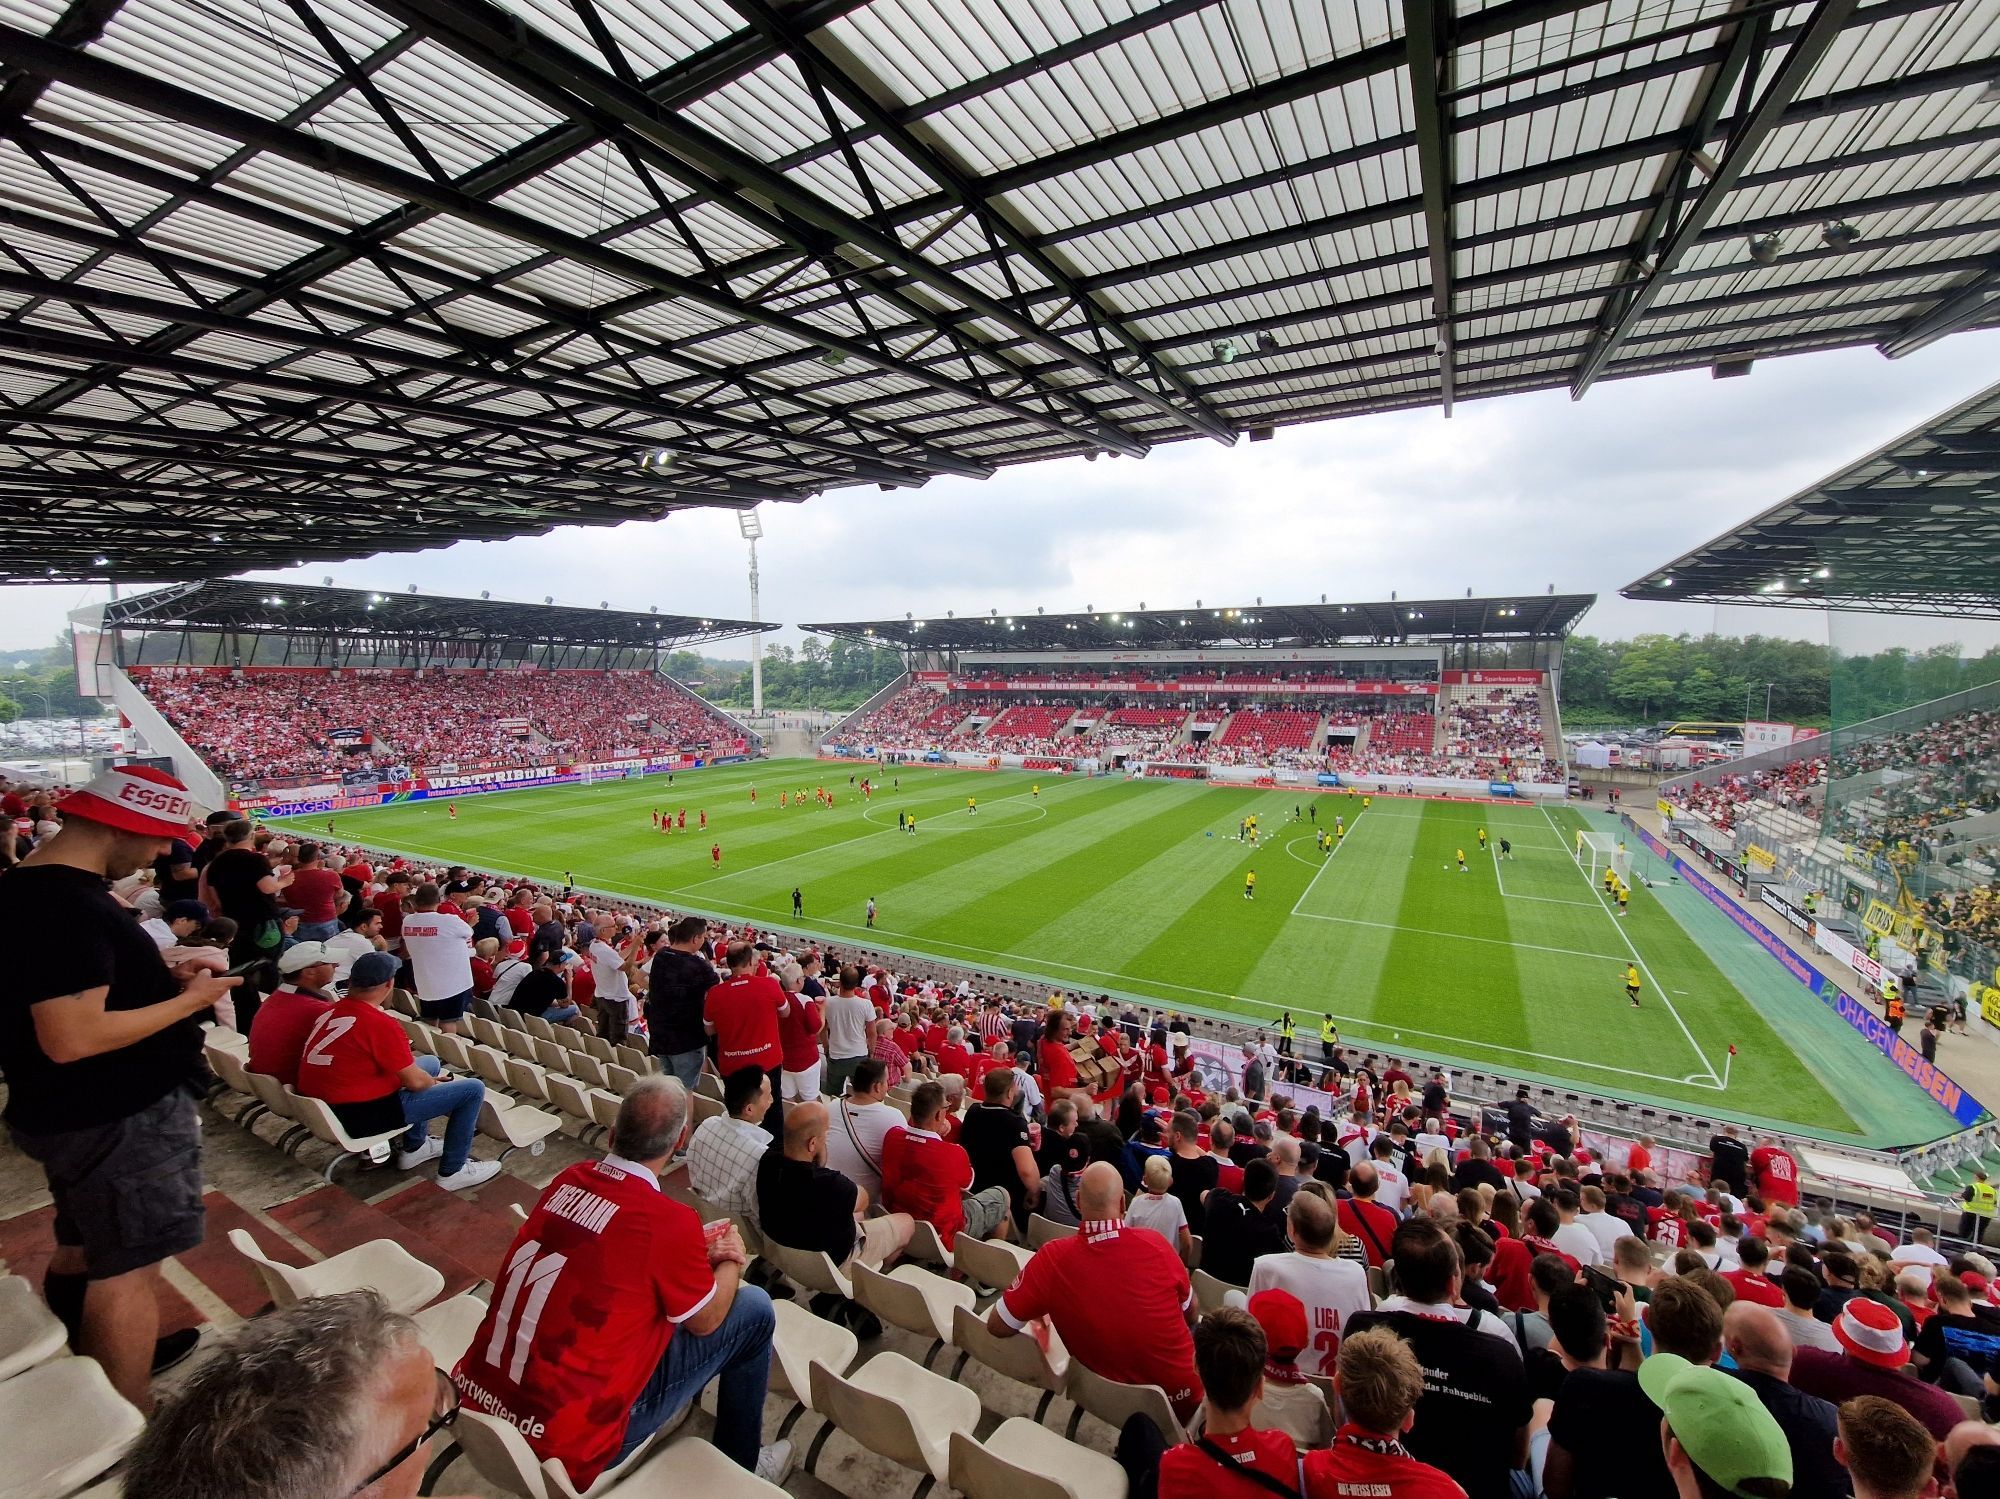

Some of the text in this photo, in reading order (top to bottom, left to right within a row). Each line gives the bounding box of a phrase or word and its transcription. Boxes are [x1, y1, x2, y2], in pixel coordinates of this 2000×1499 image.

[651, 754, 681, 765] ESSEN
[428, 766, 557, 789] WESTTRIBÜNE
[500, 776, 539, 789] Transparent
[540, 776, 553, 784] und
[303, 1008, 357, 1066] 12
[724, 1043, 772, 1058] sportwetten.de
[543, 1184, 620, 1234] ENGELMANN
[1656, 1219, 1680, 1248] 29
[486, 1240, 568, 1385] 11
[1314, 1307, 1340, 1330] LIGA
[1314, 1331, 1339, 1377] 2
[1371, 1484, 1392, 1498] ESSEN
